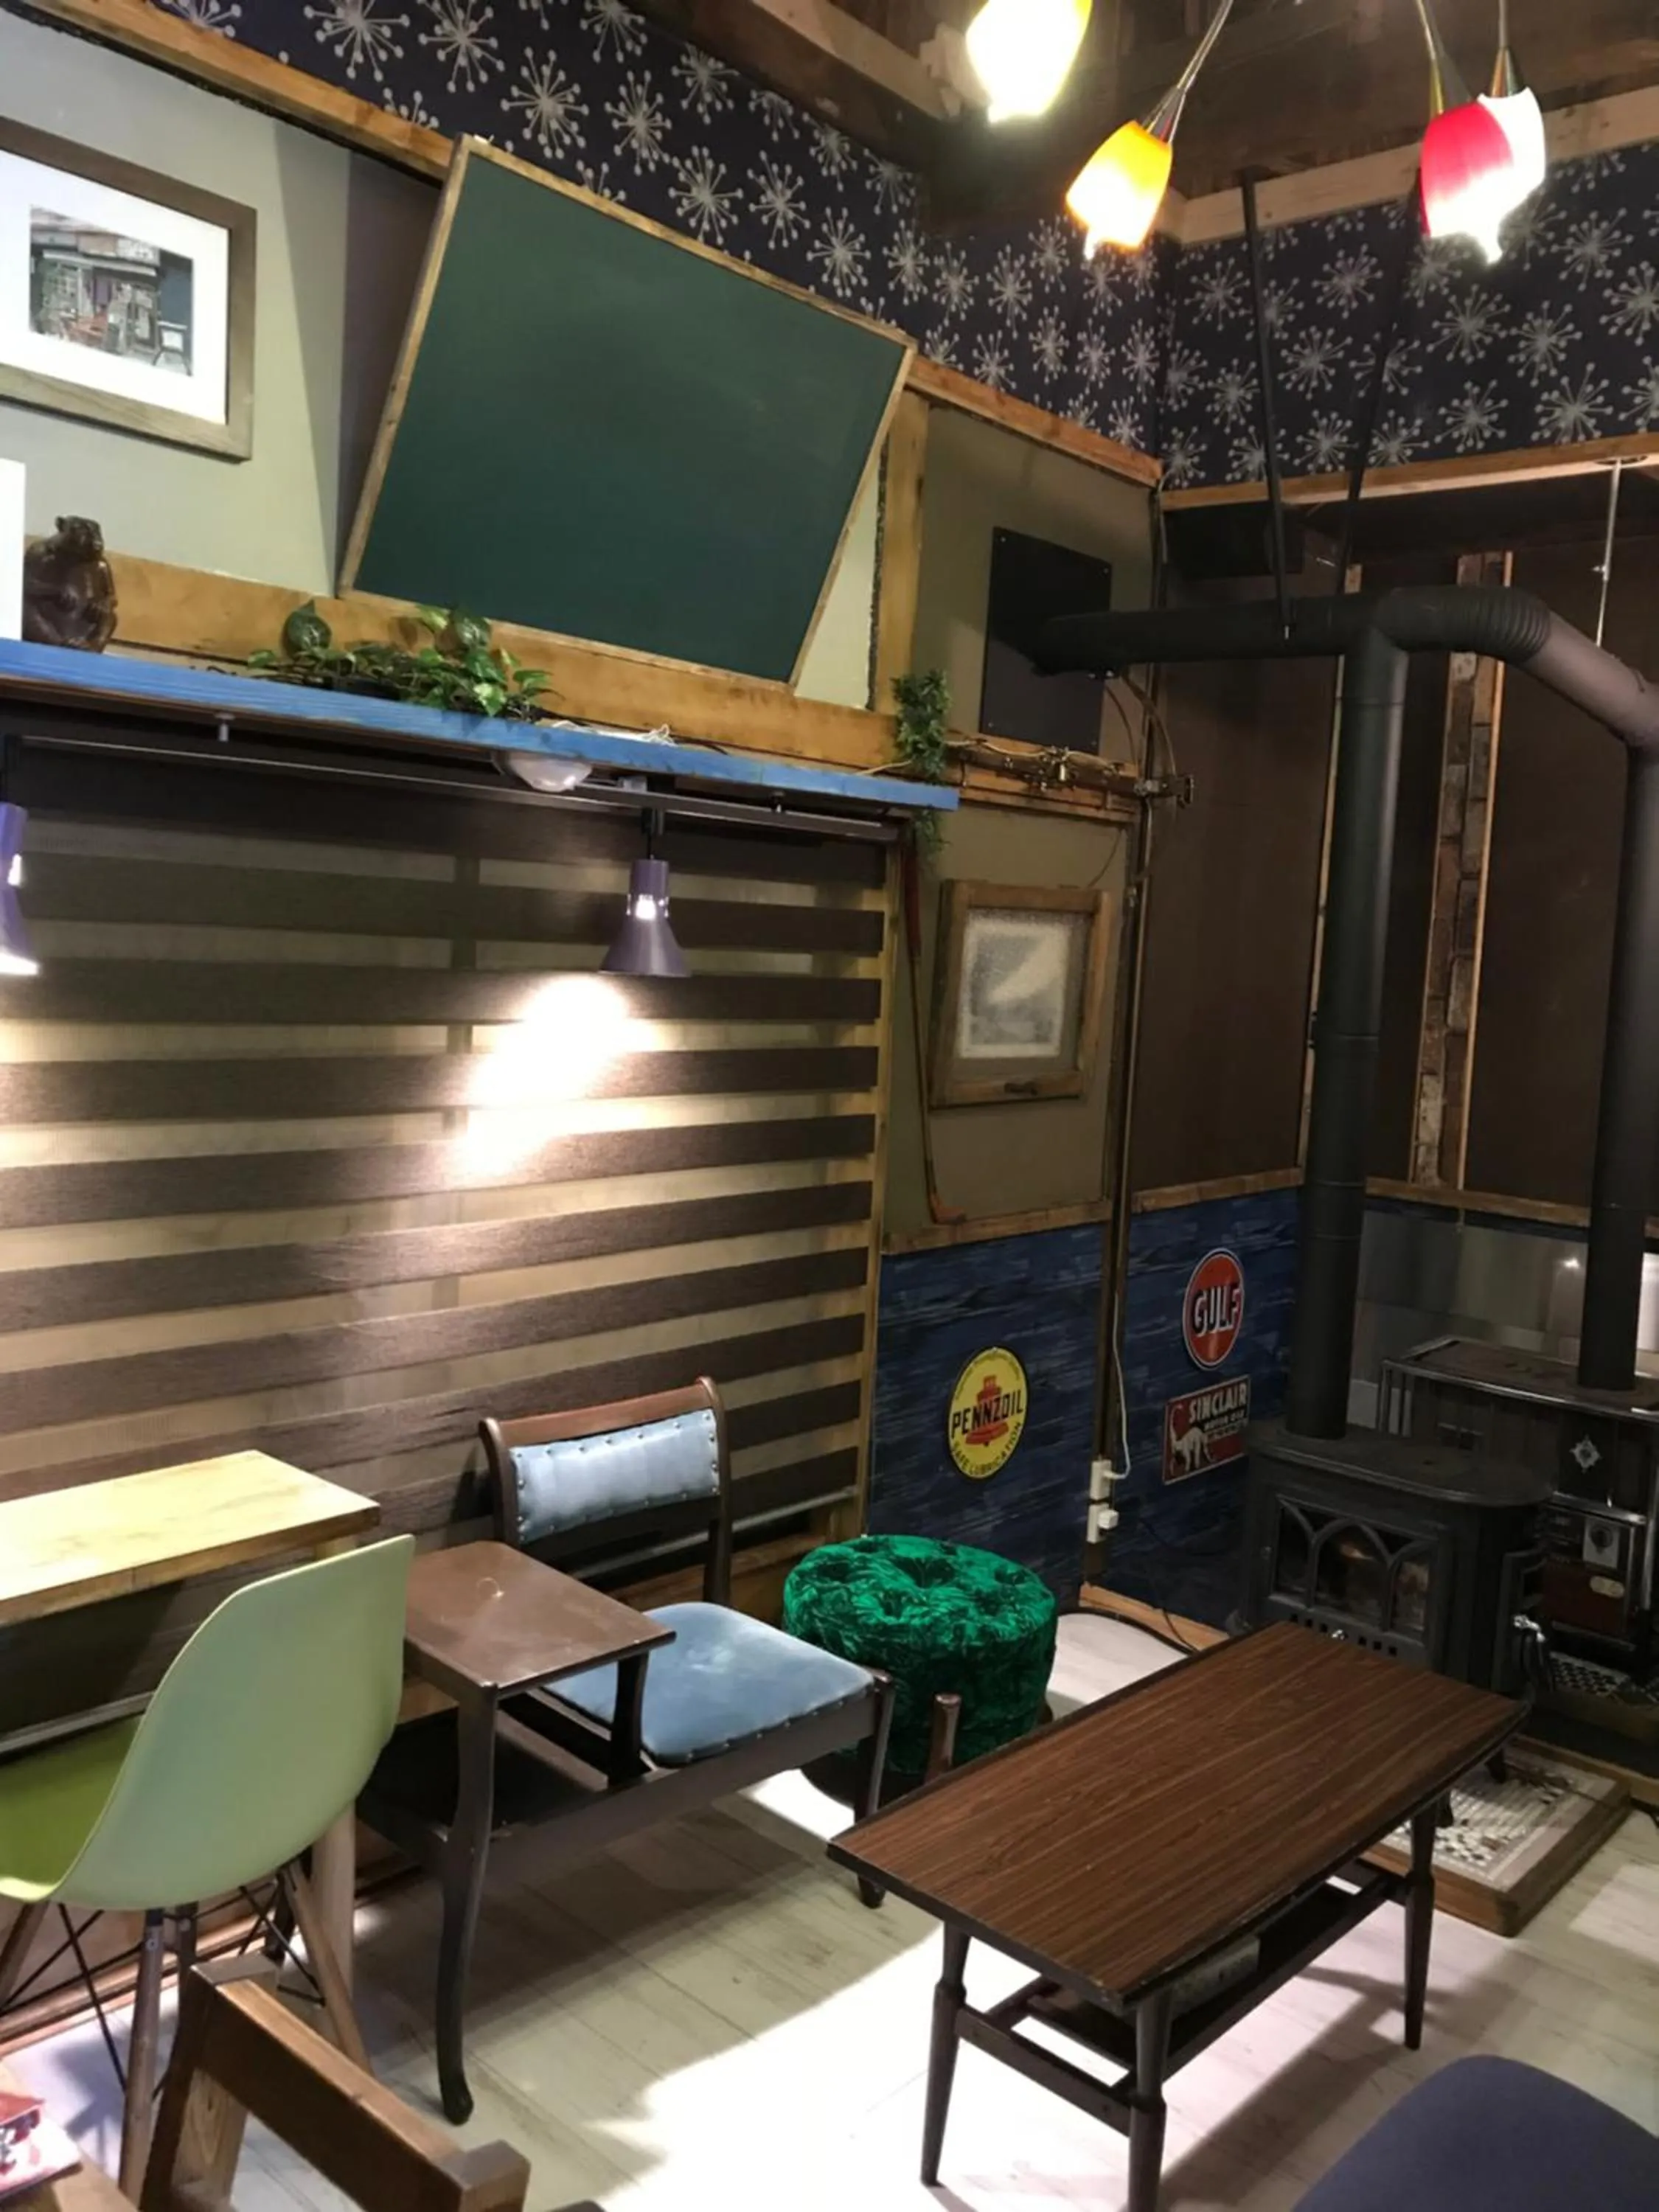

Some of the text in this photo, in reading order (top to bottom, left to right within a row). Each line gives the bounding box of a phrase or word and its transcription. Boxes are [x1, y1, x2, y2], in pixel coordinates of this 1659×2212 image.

[1193, 1281, 1241, 1338] GULF
[951, 1389, 1023, 1439] PENNZOIL
[1189, 1382, 1248, 1424] SINCLAIR
